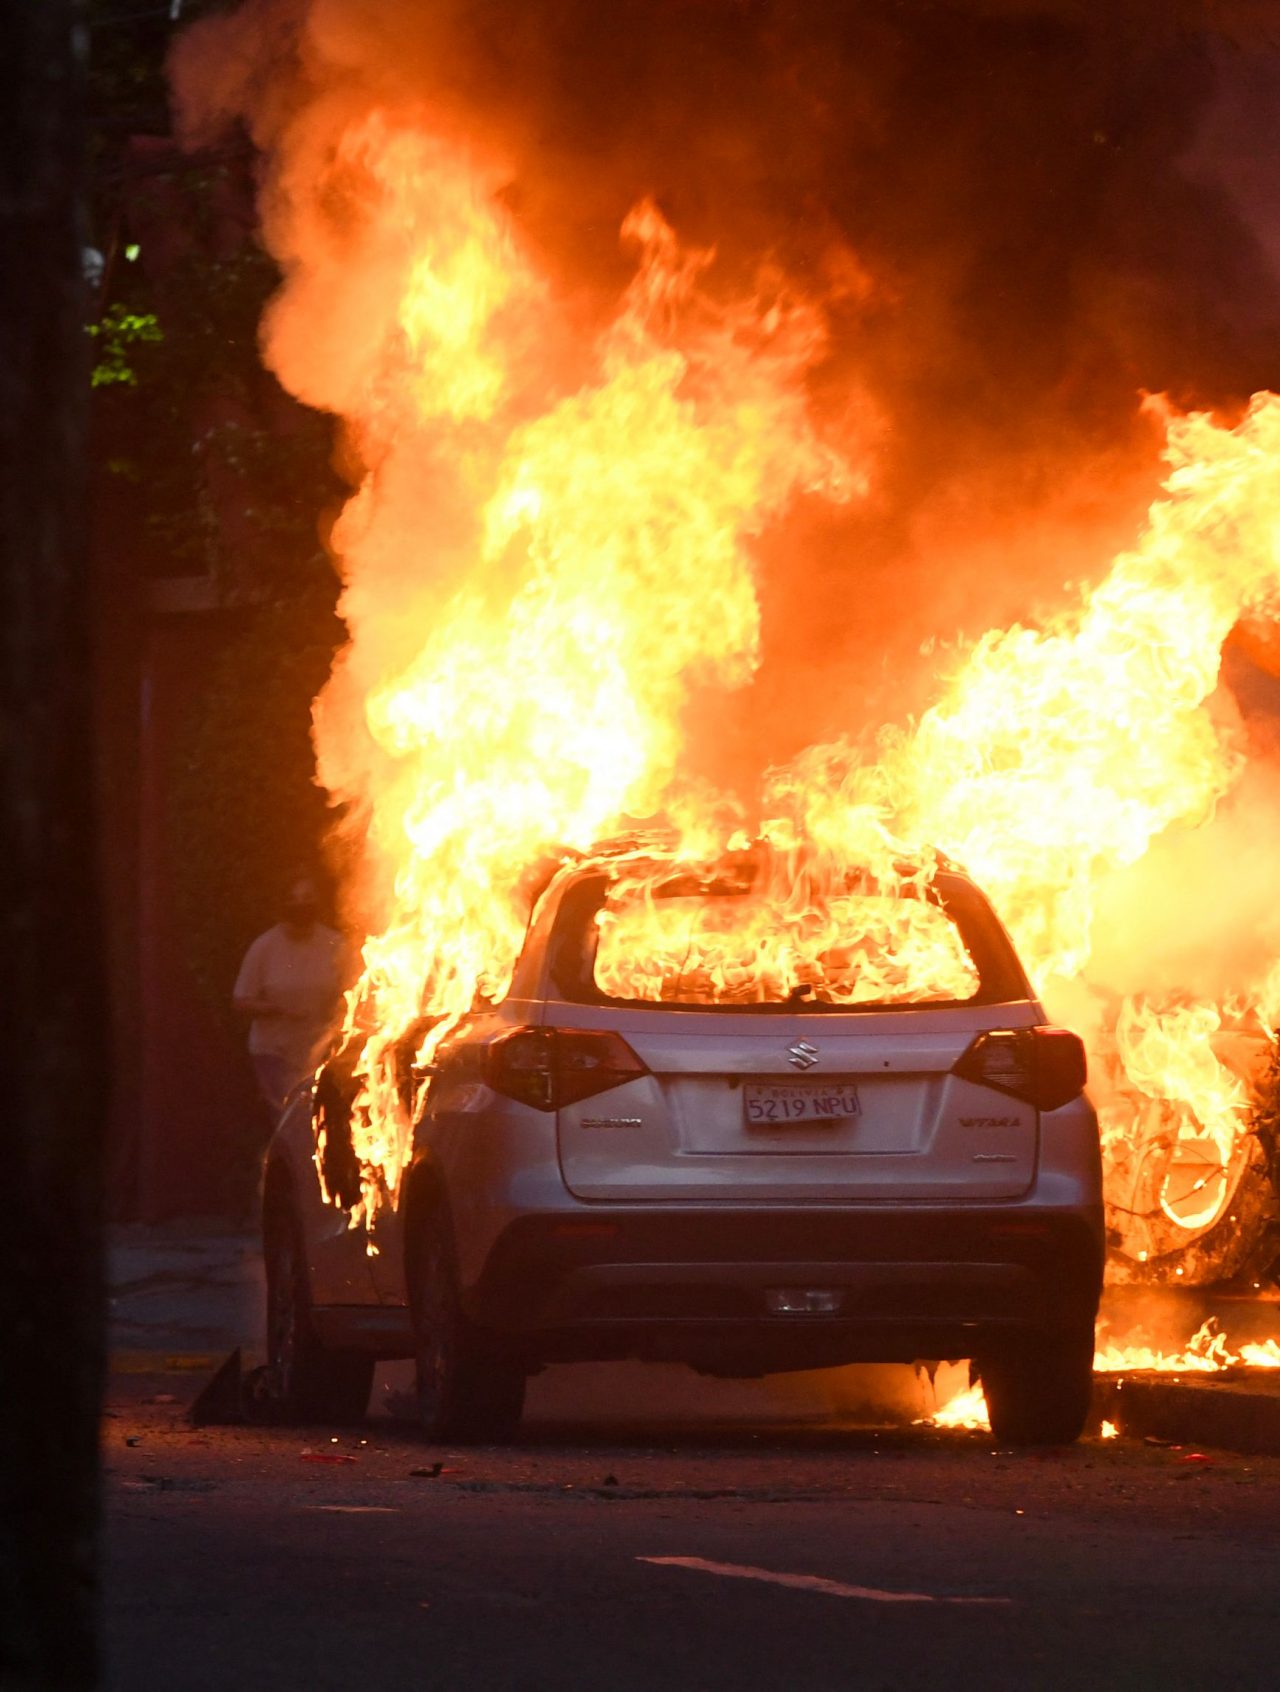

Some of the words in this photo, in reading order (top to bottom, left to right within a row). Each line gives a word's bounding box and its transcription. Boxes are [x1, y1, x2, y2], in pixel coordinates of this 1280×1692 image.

[771, 1088, 828, 1098] BOLIVIA
[749, 1099, 806, 1119] 5219
[813, 1097, 857, 1115] NPU
